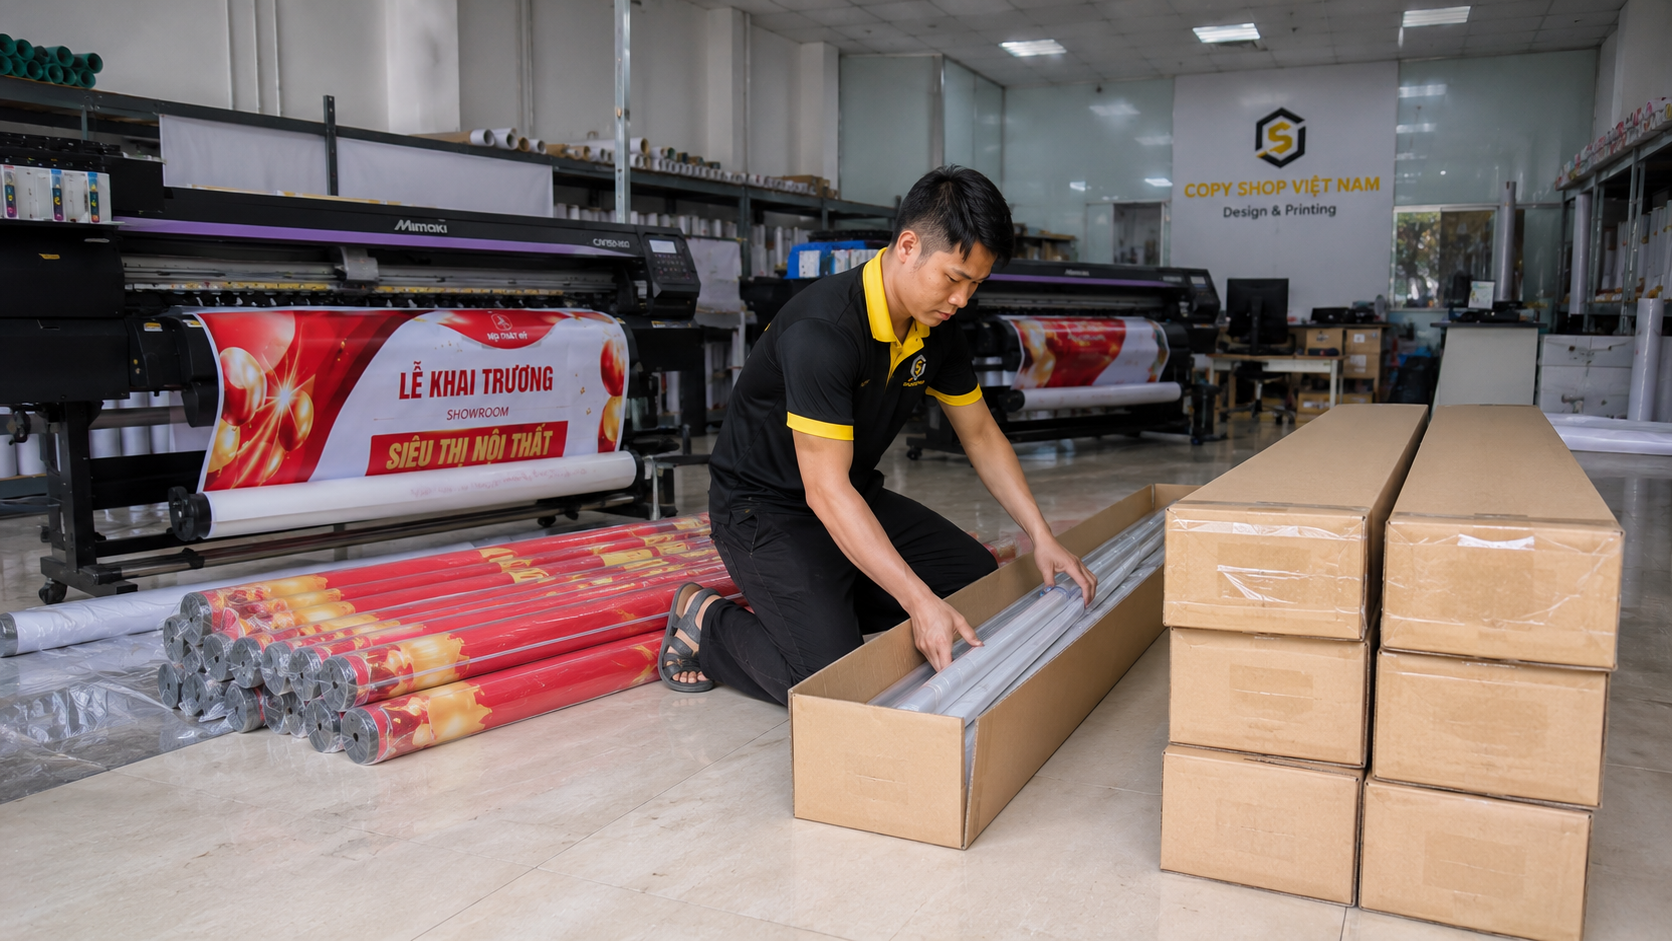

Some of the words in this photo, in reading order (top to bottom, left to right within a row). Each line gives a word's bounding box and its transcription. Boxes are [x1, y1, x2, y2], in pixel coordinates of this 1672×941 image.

[1184, 182, 1232, 198] COPY
[1237, 180, 1287, 196] SHOP
[1292, 175, 1332, 198] VIỆT
[1337, 176, 1380, 193] NAM
[1223, 205, 1267, 220] Design
[1271, 205, 1281, 217] &
[1285, 203, 1337, 217] Printing
[394, 219, 447, 233] Mimaki
[399, 361, 423, 400] LỄ
[429, 369, 476, 398] KHAI
[482, 364, 554, 395] TRƯƠNG
[446, 406, 509, 420] SHOWROOM
[385, 434, 433, 470] SIÊU
[437, 439, 468, 467] THỊ
[510, 423, 553, 458] THẤT
